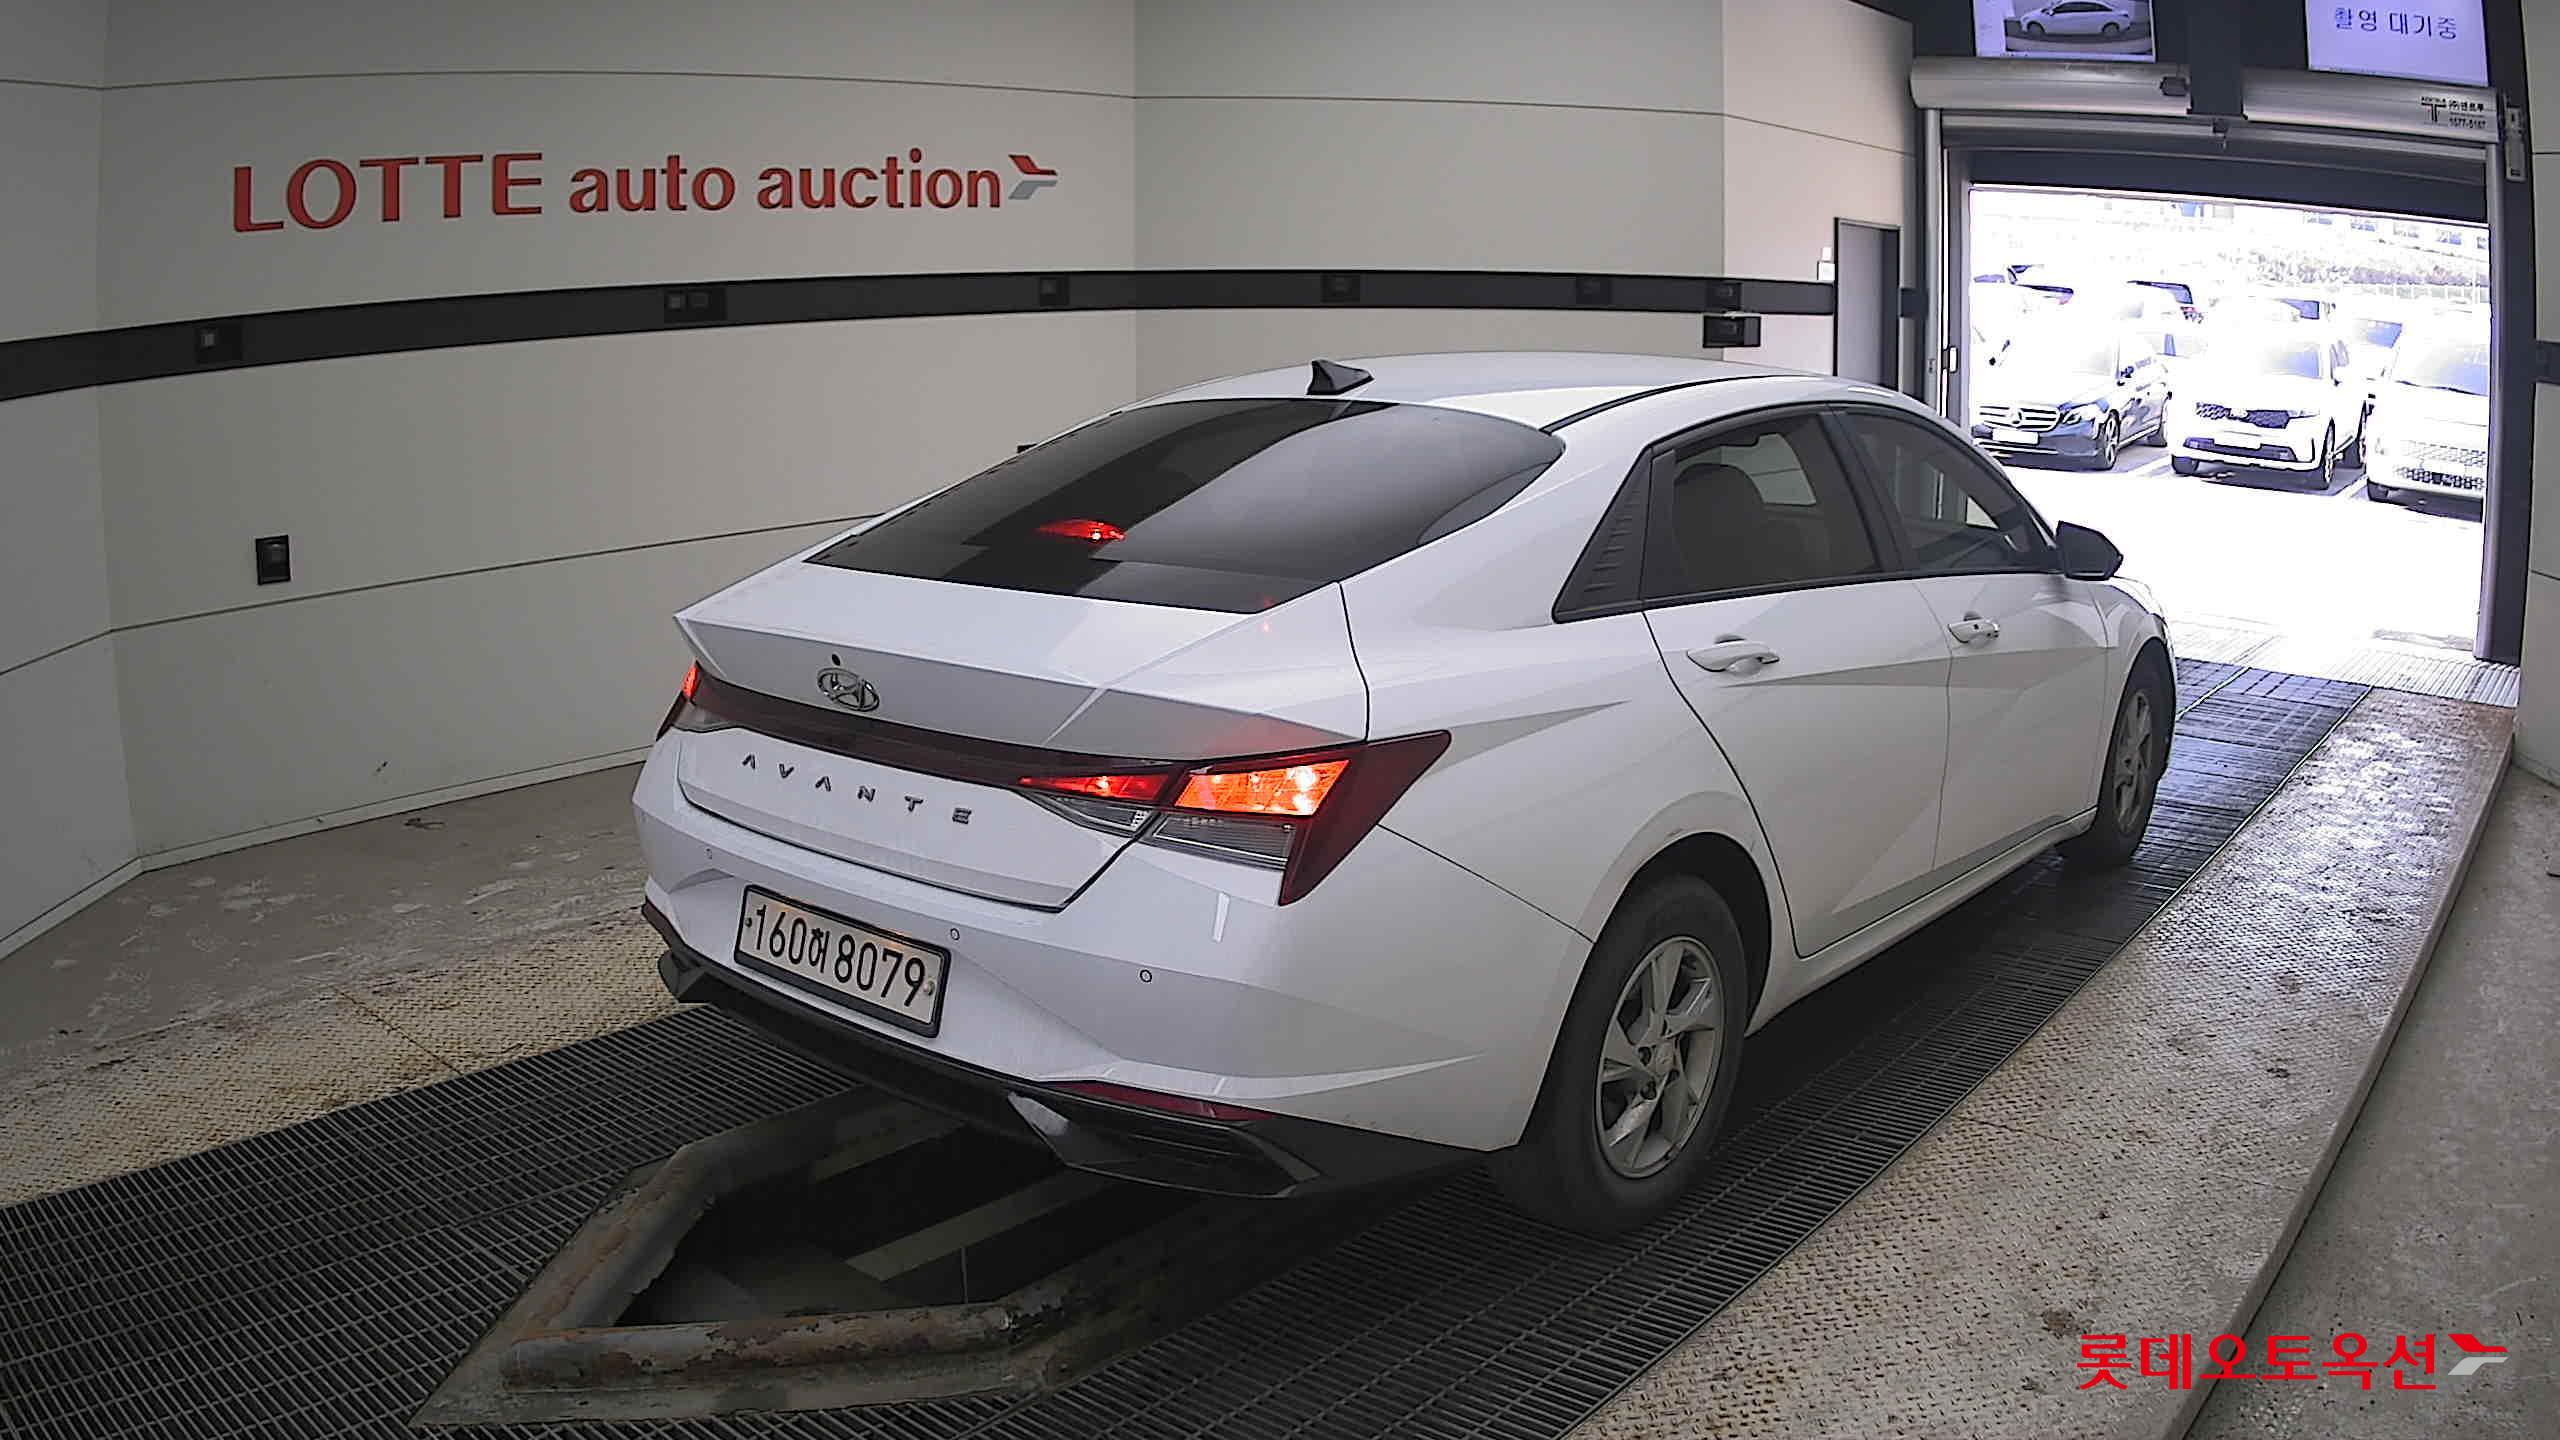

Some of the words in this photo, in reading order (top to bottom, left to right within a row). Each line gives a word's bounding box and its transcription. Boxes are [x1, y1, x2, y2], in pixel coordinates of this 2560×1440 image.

[2335, 7, 2377, 31] 촬영
[2389, 12, 2457, 40] 대기중
[233, 153, 542, 233] LOTTE
[569, 155, 736, 213] auto
[757, 148, 1001, 210] auction
[741, 753, 972, 825] AVANTE
